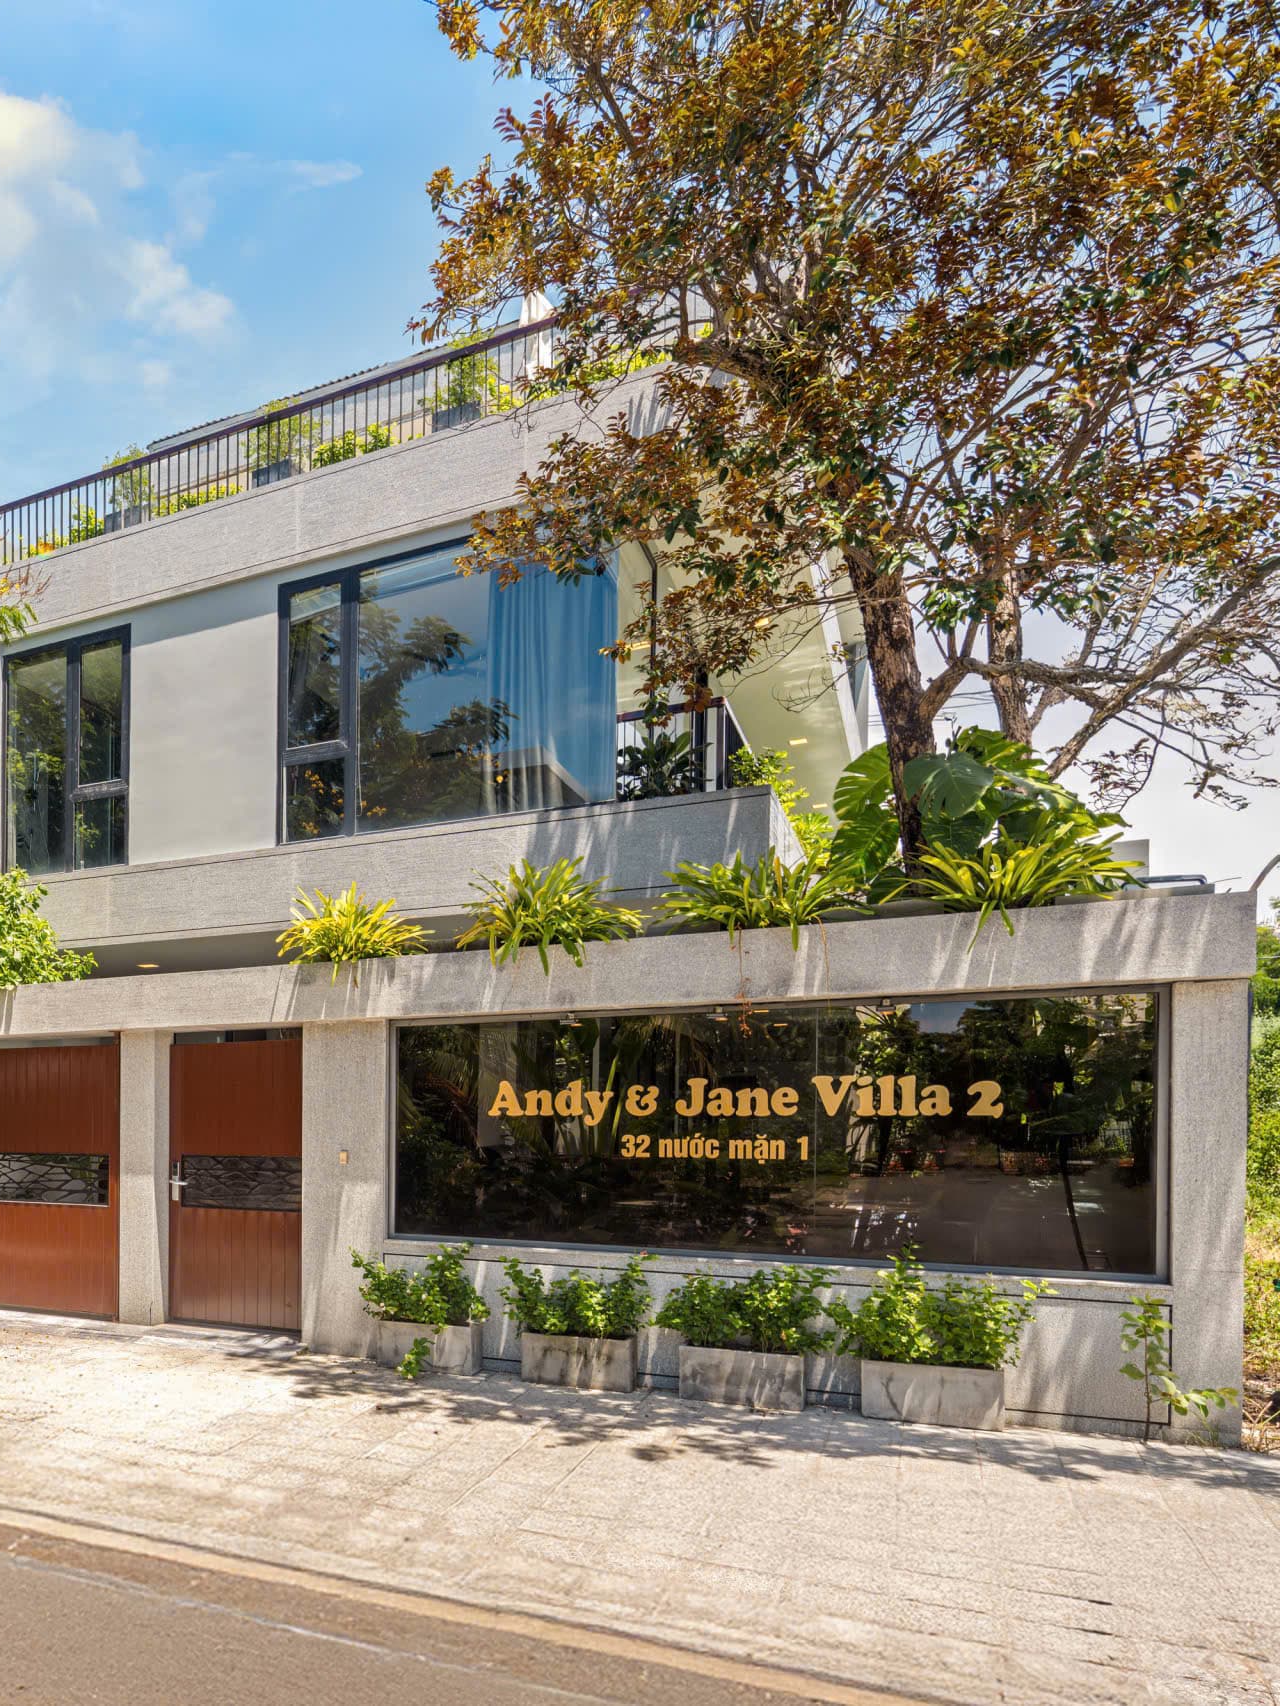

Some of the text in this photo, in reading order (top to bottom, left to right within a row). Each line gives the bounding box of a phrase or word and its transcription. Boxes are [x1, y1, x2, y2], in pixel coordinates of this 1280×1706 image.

[487, 1074, 1004, 1127] Andy & Jane Villa 2
[621, 1132, 809, 1165] 32 nước mặn 1
